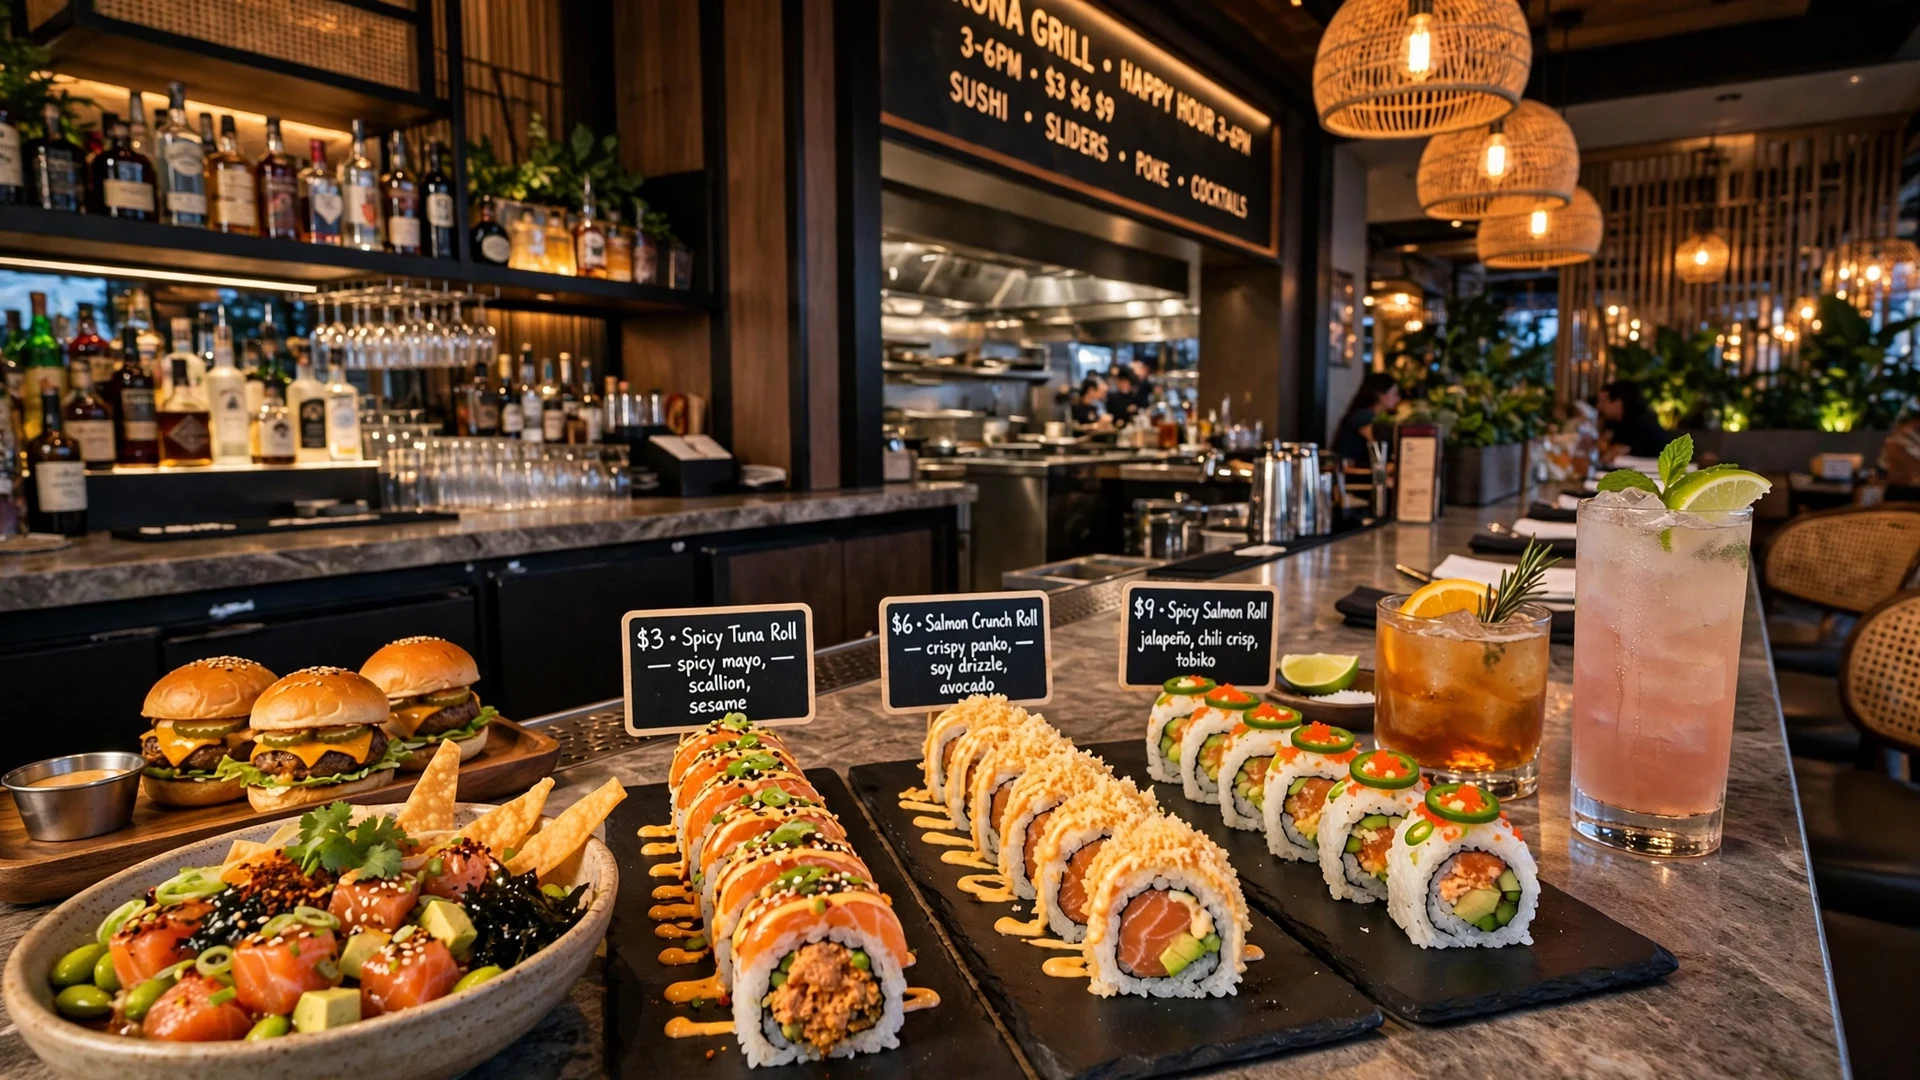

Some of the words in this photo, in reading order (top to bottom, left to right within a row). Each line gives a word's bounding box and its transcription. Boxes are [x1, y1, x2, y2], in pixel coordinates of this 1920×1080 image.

[960, 26, 1022, 81] 3-6PM
[1045, 65, 1066, 100] $3
[1070, 78, 1091, 112] $6
[1095, 90, 1115, 123] $9
[1031, 9, 1095, 74] GRILL
[1120, 58, 1174, 113] HAPPY
[1176, 91, 1215, 137] HOUR
[950, 71, 1008, 121] SUSHI
[1045, 112, 1109, 162] SLIDERS
[1135, 150, 1170, 188] POKE
[1191, 174, 1248, 219] COCKTAILS
[892, 612, 913, 635] $6
[925, 613, 968, 632] Salmon
[972, 611, 1012, 629] Crunch
[1016, 608, 1038, 627] Roll
[1134, 596, 1155, 619] $9
[1167, 600, 1199, 625] Spicy
[1203, 601, 1243, 619] Salmon
[1247, 601, 1267, 619] Roll
[637, 627, 664, 651] $3
[682, 627, 723, 652] Spicy
[728, 624, 764, 643] Tuna
[771, 621, 797, 641] Roll
[926, 640, 965, 658] crispy
[971, 635, 1012, 658] panko,
[1137, 629, 1195, 652] jalapeño,
[1198, 629, 1222, 646] chili
[1226, 632, 1259, 652] crisp,
[677, 655, 715, 677] spicy
[722, 655, 766, 674] mayo,
[930, 663, 953, 680] soy
[958, 655, 1007, 674] drizzle,
[1176, 651, 1216, 667] tobiko
[689, 674, 751, 693] scallion,
[939, 675, 995, 694] avocado
[689, 698, 747, 714] sesame
